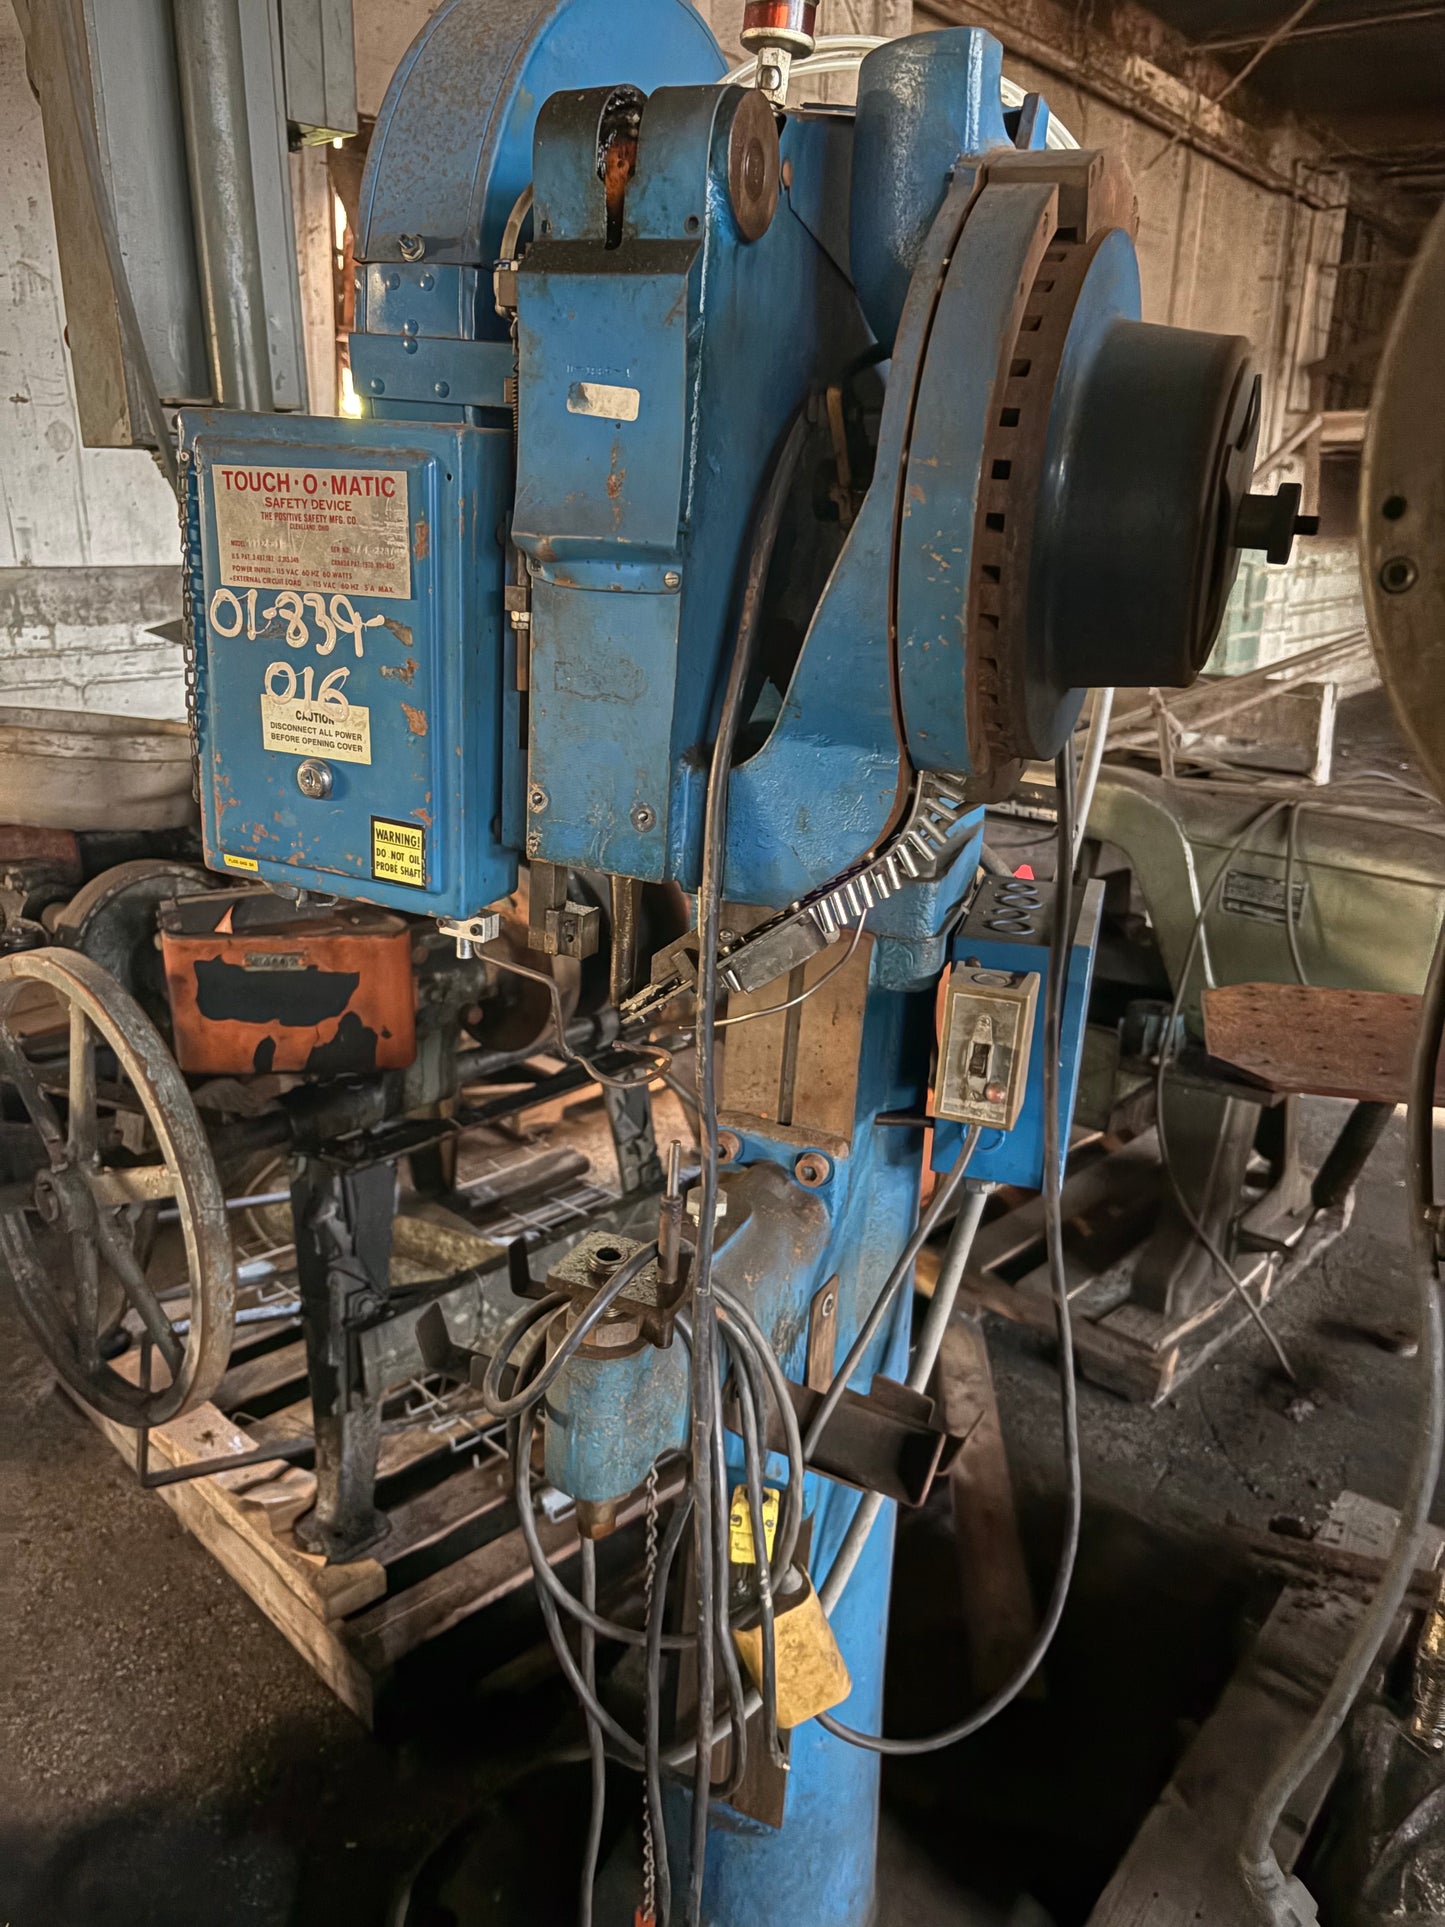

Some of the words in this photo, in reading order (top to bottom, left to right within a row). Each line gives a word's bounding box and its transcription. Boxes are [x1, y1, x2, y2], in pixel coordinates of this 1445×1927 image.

[222, 470, 290, 493] TOUCH
[331, 475, 396, 498] MATIC
[265, 497, 307, 510] SAFETY
[311, 499, 352, 511] DEVICE
[260, 511, 272, 521] THE
[274, 512, 302, 522] POSITIVE
[303, 513, 327, 523] SAFETY
[329, 515, 345, 525] MFG.
[232, 565, 252, 573] POWER
[332, 572, 353, 580] WATTS
[262, 577, 284, 585] CIRCUIT
[285, 578, 302, 587] LOAD
[323, 581, 336, 589] VAC
[351, 583, 360, 591] HZ
[265, 661, 350, 722] 016
[270, 721, 317, 735] DISCONNECT
[319, 728, 333, 738] ALL
[335, 730, 362, 741] POWER
[270, 732, 300, 744] BEFORE
[301, 737, 335, 749] OPENING
[337, 742, 363, 752] COVER
[375, 828, 420, 848] WARNING!
[376, 847, 386, 858] DO
[391, 850, 405, 862] NOT
[409, 854, 420, 865] OIL
[376, 861, 398, 874] PROBE
[400, 866, 421, 879] SHAFT
